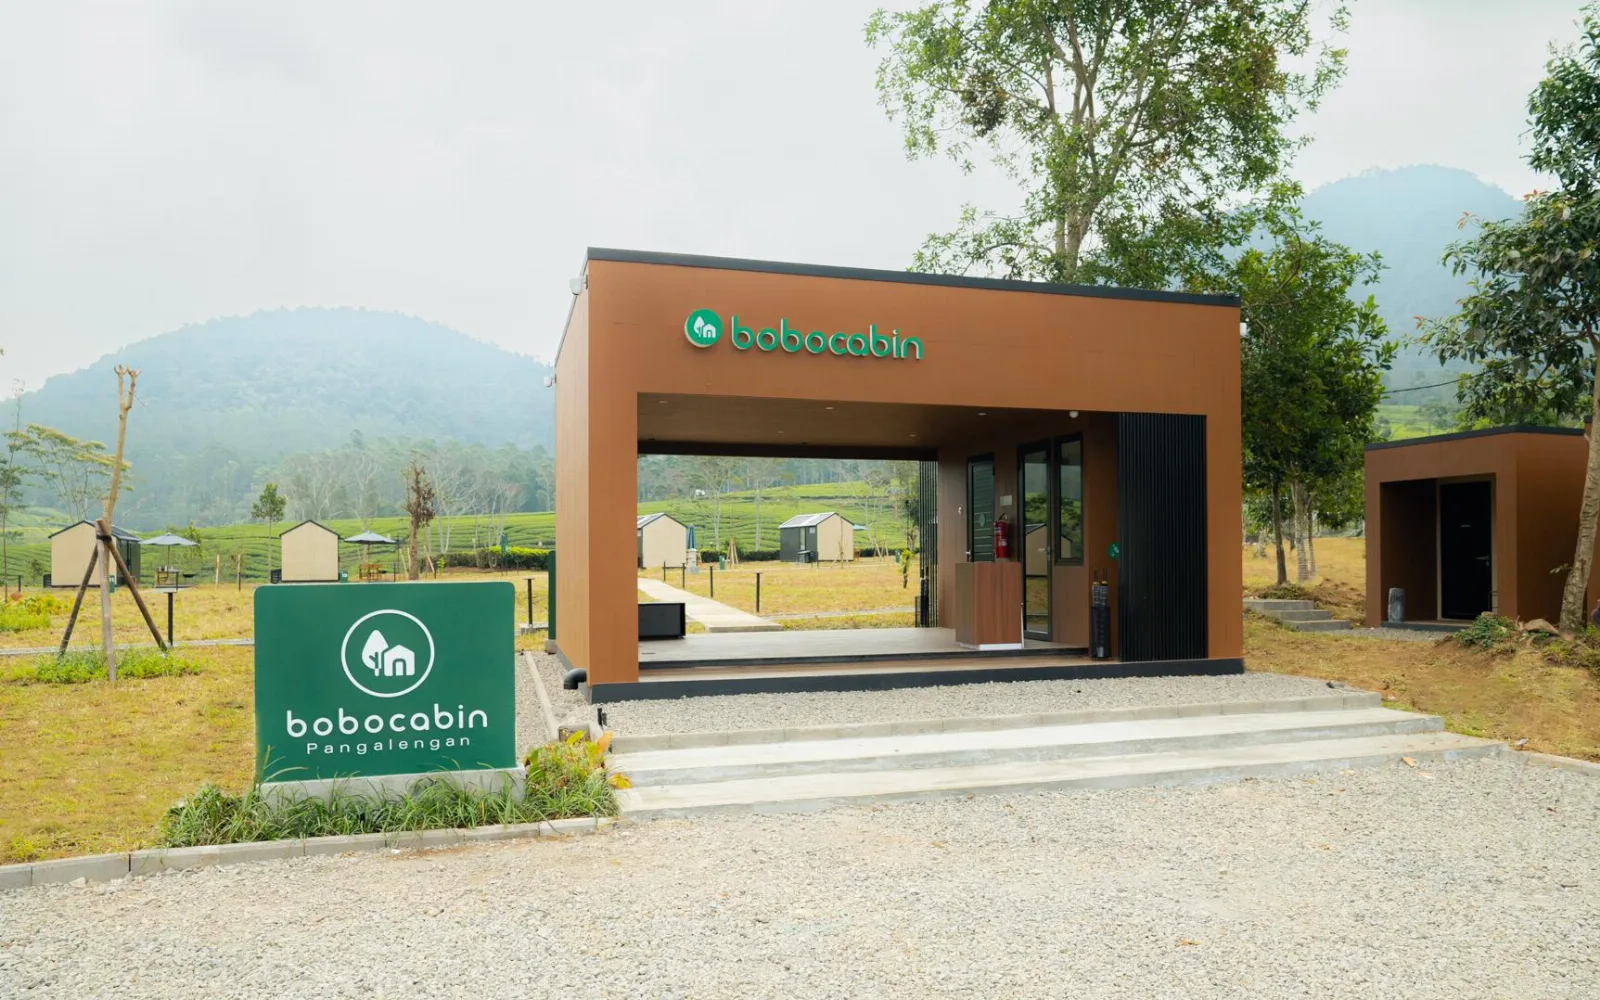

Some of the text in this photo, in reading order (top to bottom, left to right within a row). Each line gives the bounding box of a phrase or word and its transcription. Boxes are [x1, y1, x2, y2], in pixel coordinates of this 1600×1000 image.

[731, 315, 923, 360] bobocabin
[286, 703, 488, 738] bobocabin
[306, 736, 471, 755] Pangalengan
